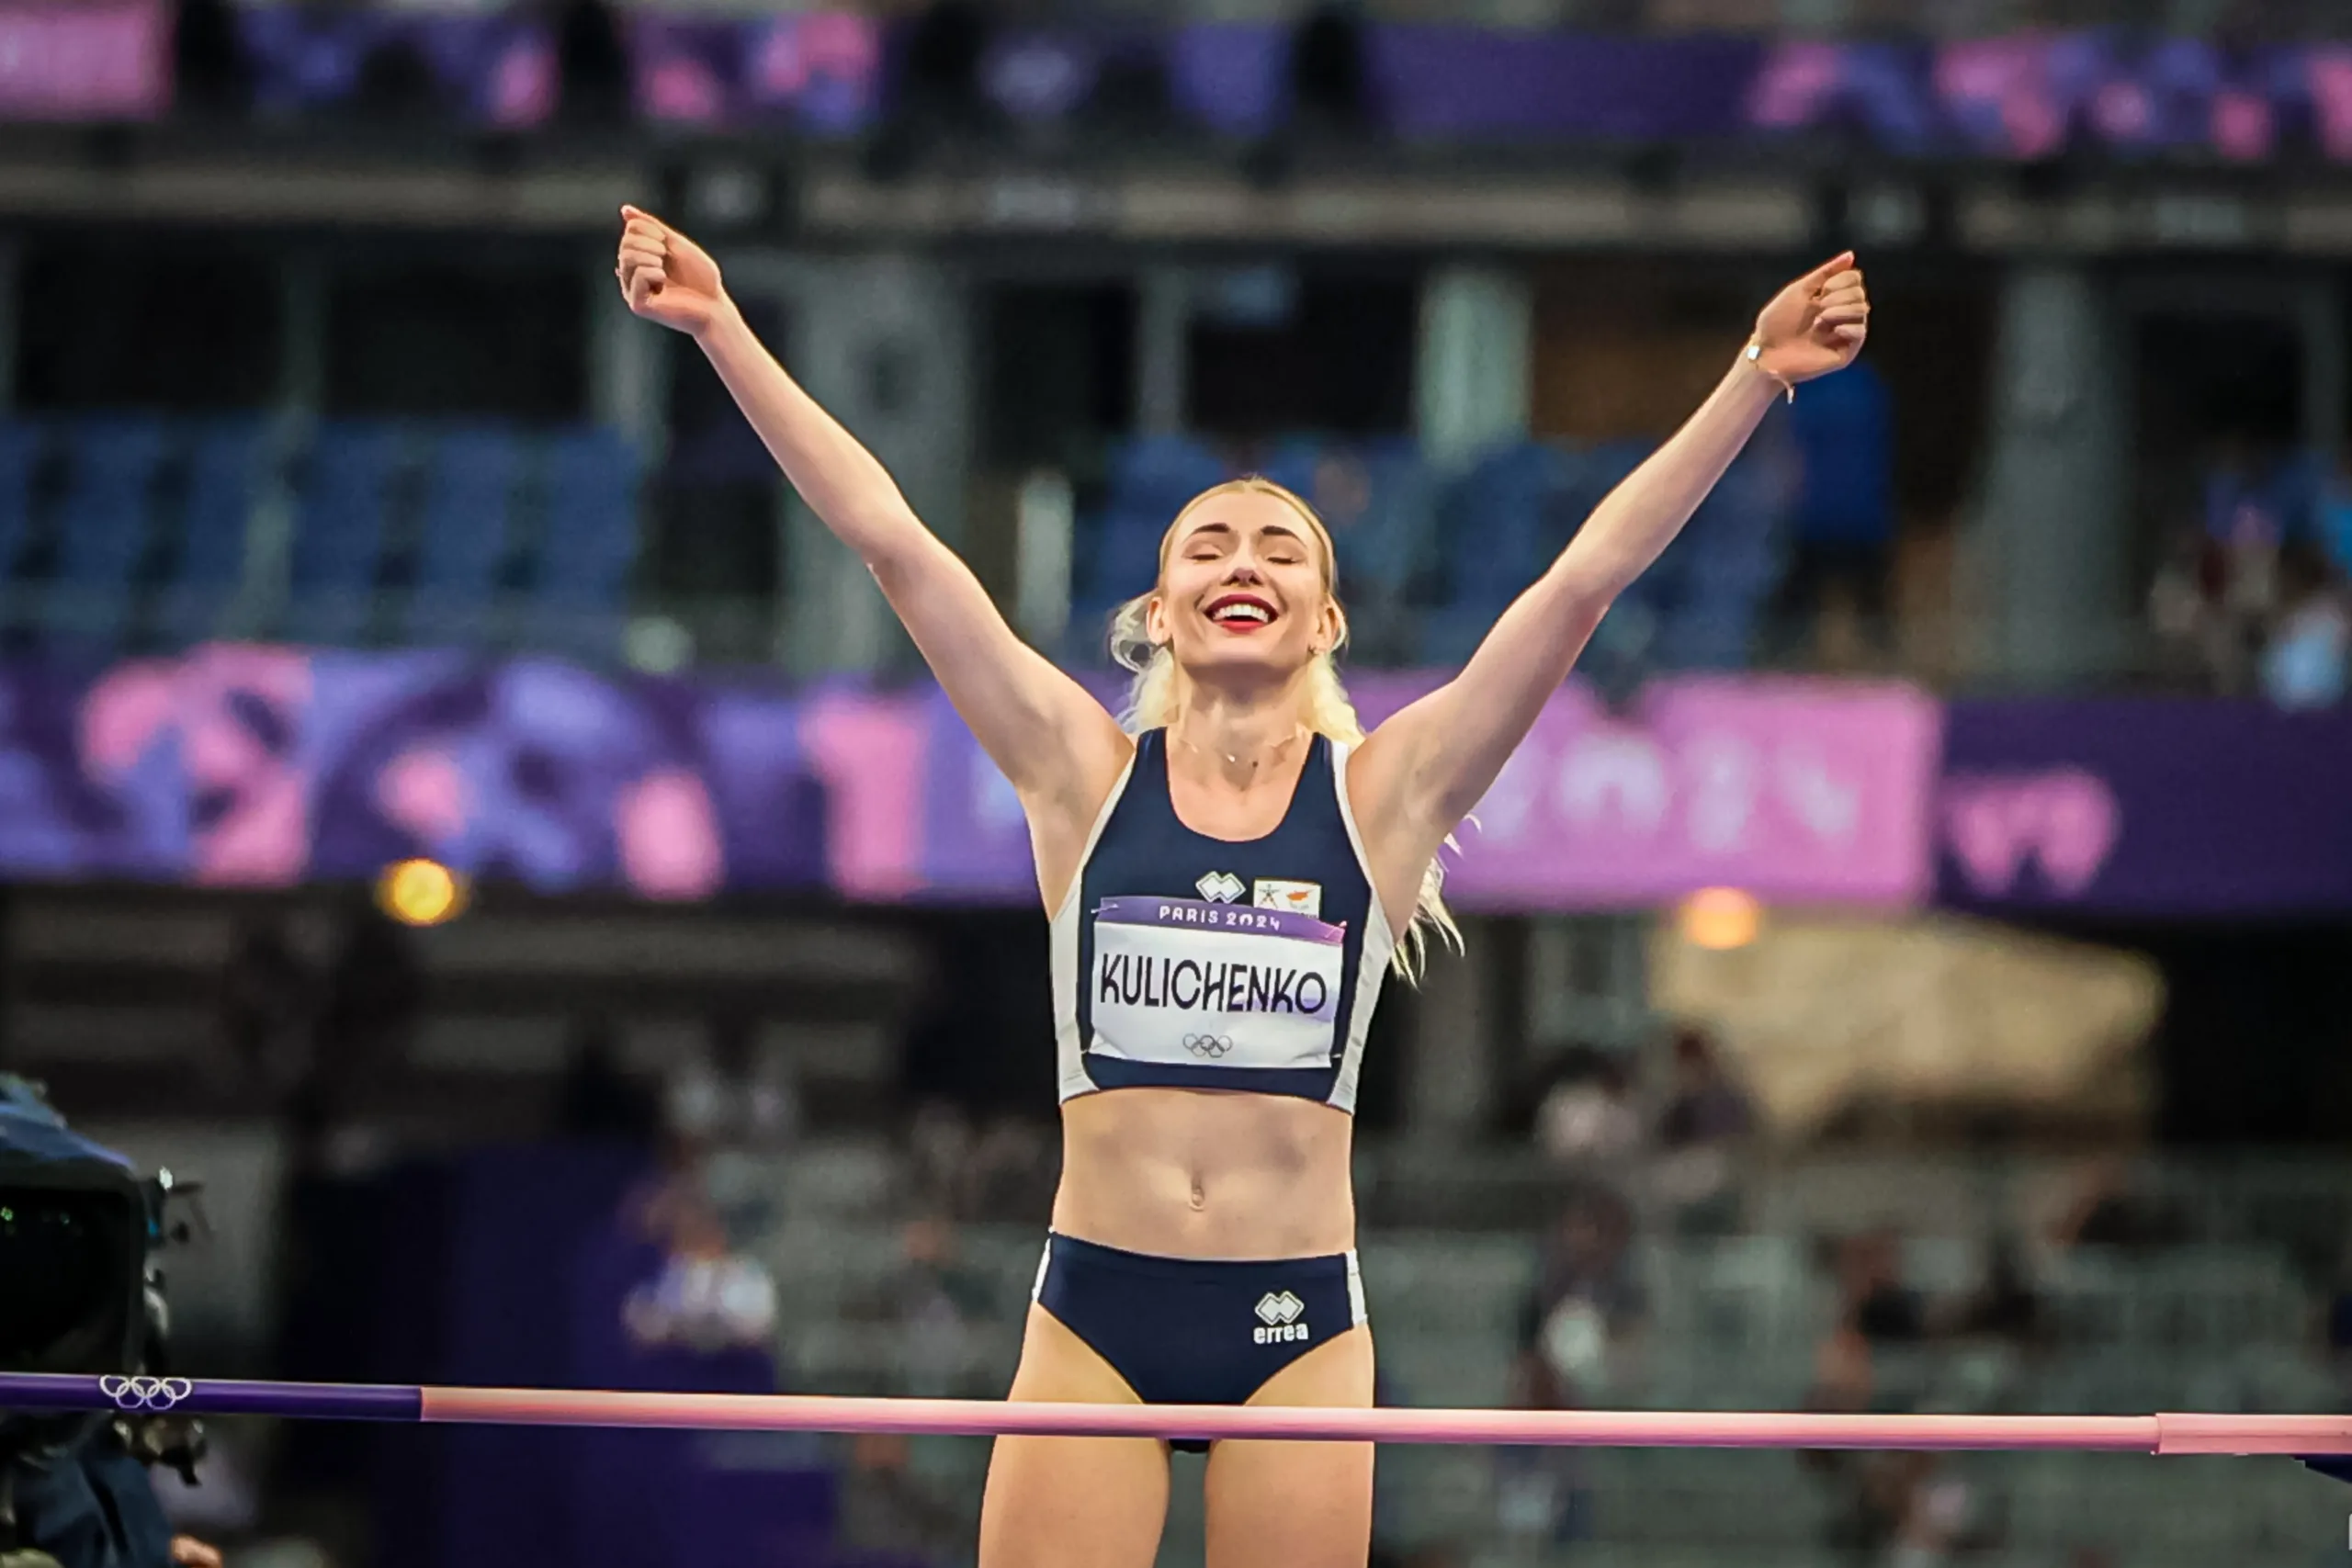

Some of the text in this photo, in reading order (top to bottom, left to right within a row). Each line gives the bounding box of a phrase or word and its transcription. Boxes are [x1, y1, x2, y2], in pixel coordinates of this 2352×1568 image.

[1159, 905, 1281, 931] PARIS 2024
[1100, 953, 1327, 1014] KULICHENKO
[1253, 1323, 1309, 1345] errea
